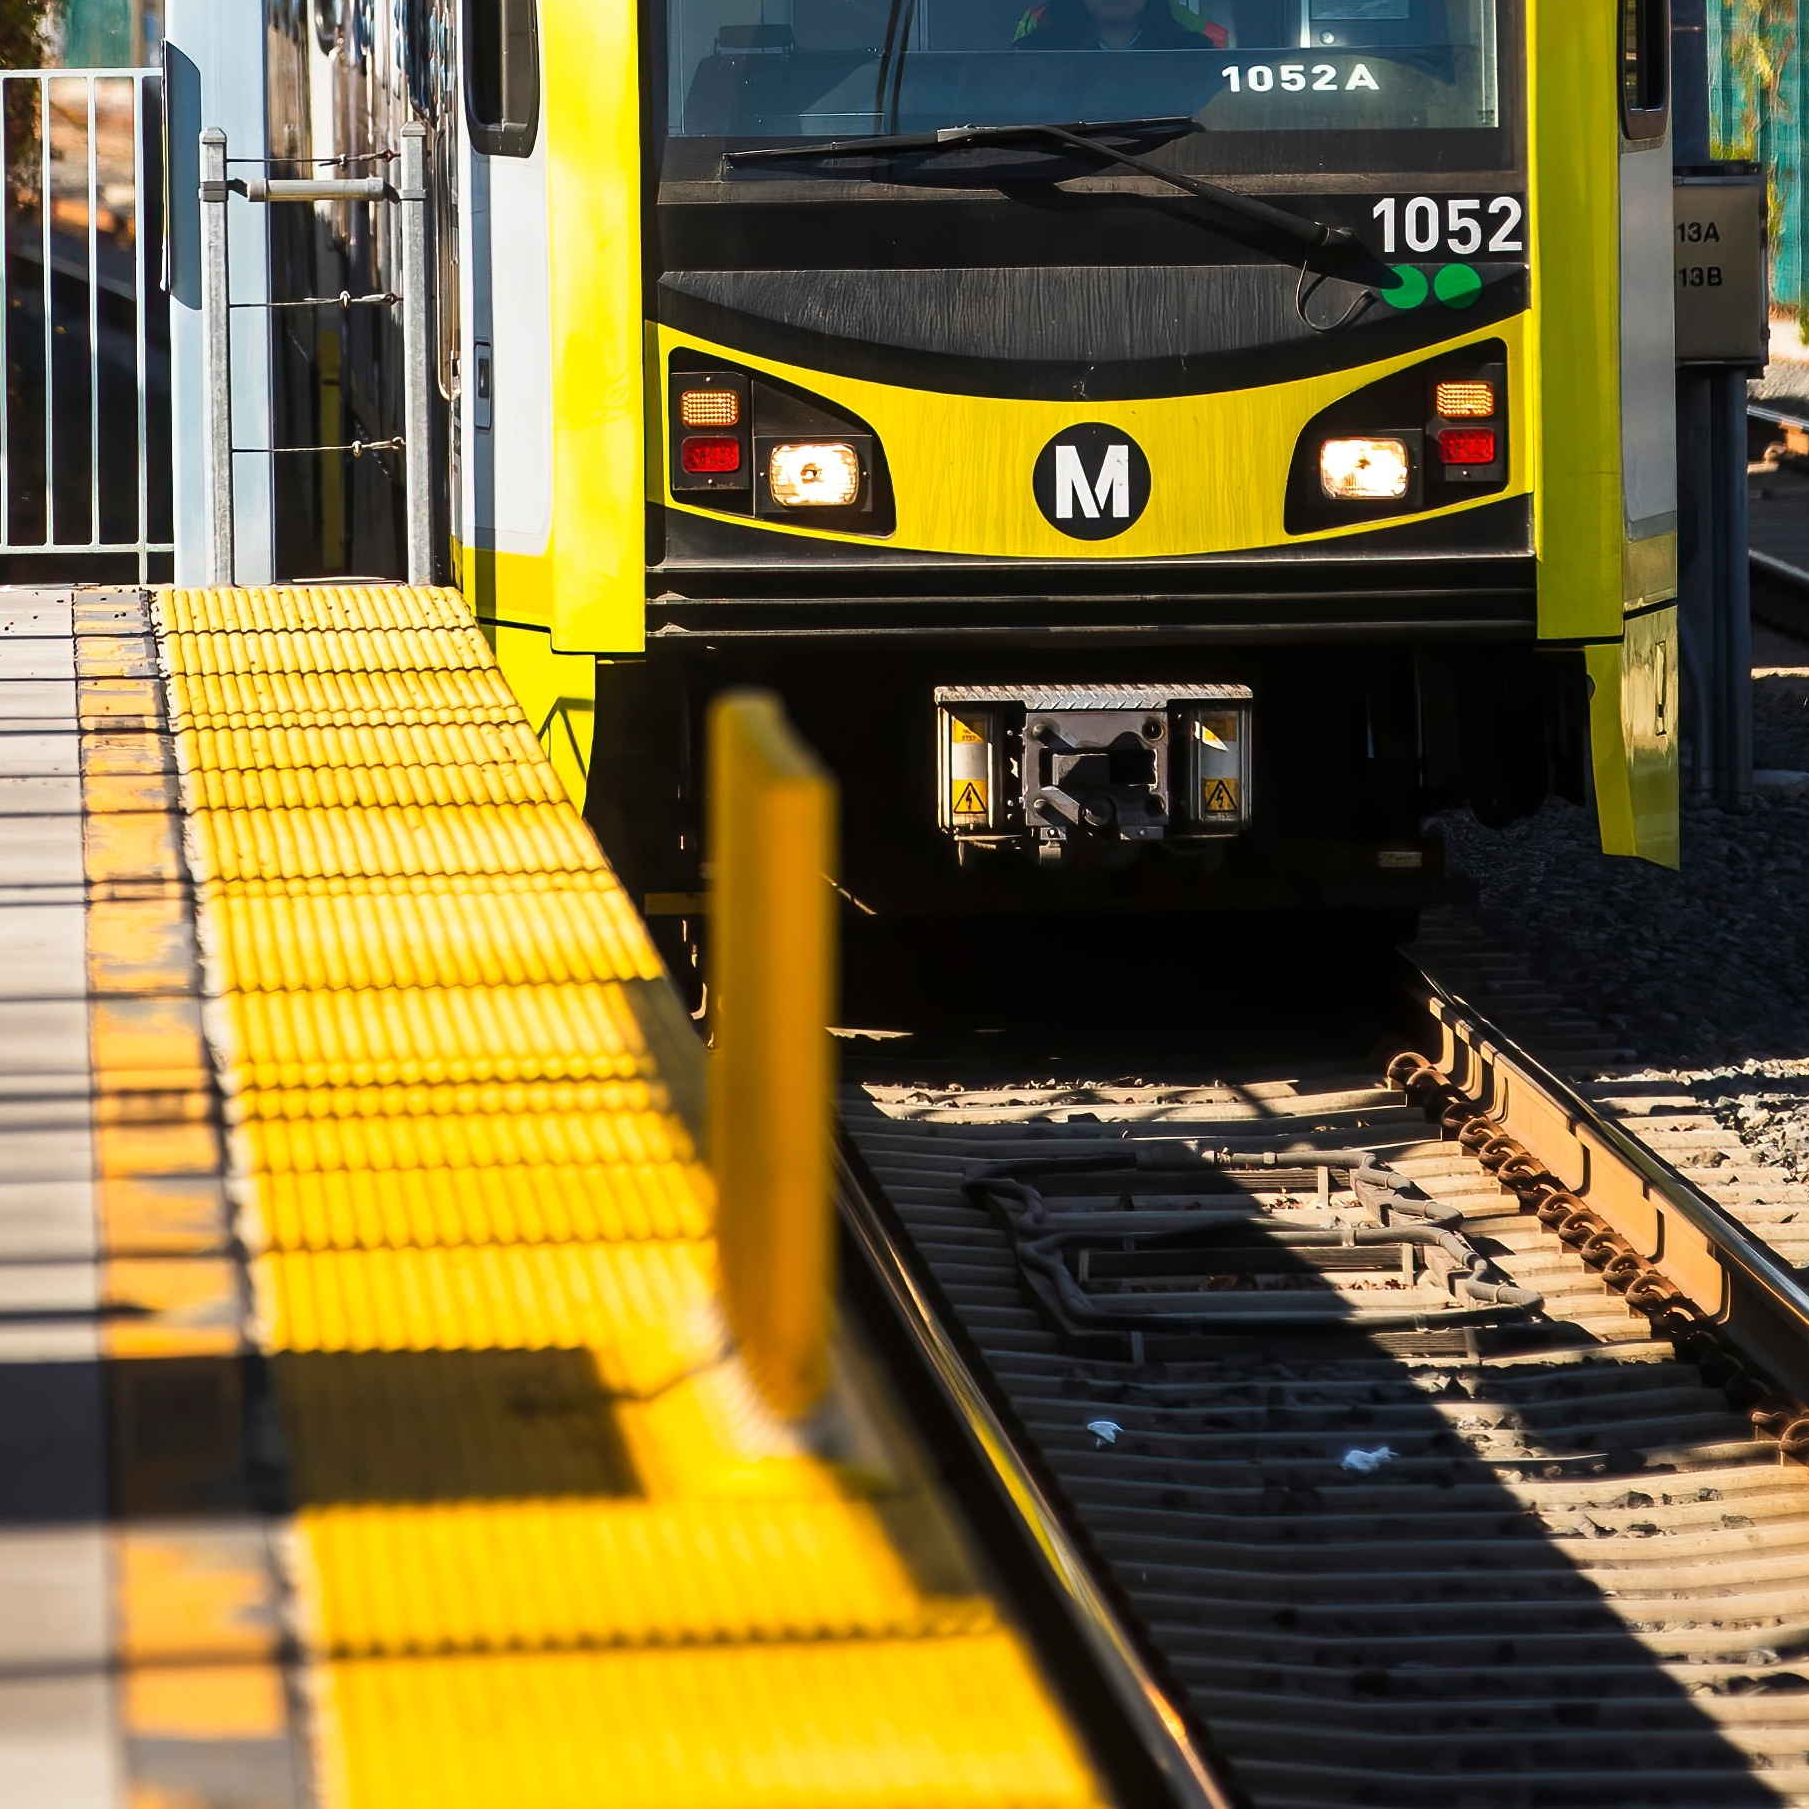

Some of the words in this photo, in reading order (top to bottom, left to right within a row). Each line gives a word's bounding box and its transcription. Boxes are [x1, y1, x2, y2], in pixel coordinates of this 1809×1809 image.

[1221, 63, 1380, 93] 1052A
[1372, 196, 1523, 255] 1052
[1676, 221, 1720, 243] 13A
[1677, 266, 1723, 287] 13B
[1055, 444, 1130, 519] M
